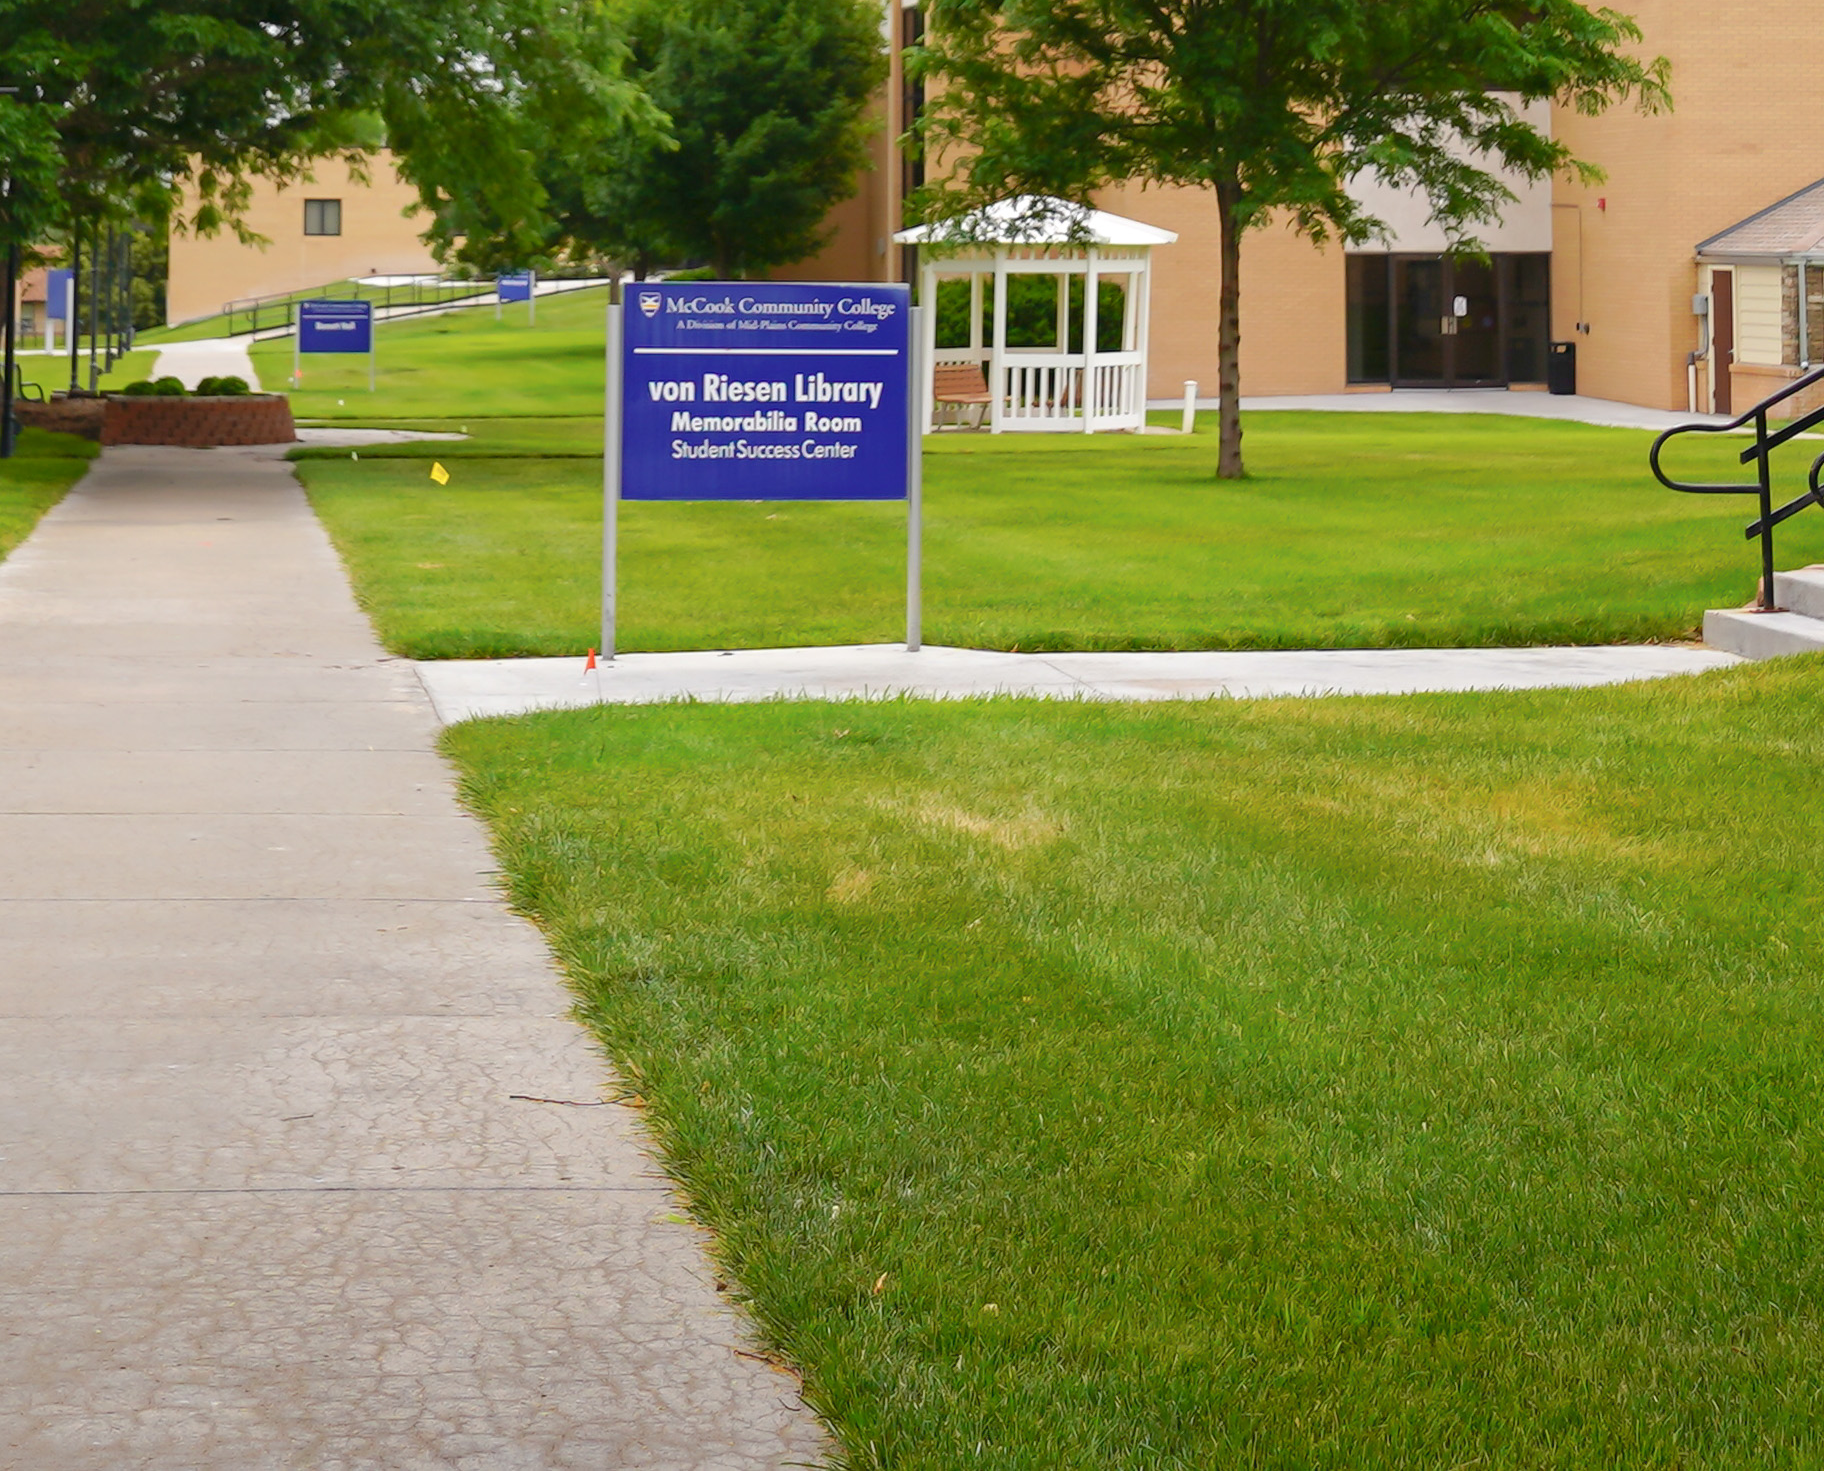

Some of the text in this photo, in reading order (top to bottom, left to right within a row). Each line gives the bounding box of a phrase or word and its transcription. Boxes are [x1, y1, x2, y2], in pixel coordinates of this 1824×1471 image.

[666, 297, 896, 320] McCook Community College
[676, 320, 686, 329] A
[686, 319, 725, 329] Division
[726, 319, 738, 329] of
[788, 320, 842, 332] Community
[844, 320, 878, 333] College
[648, 372, 884, 410] von Riesen Library
[671, 410, 862, 432] Memorabilia Room
[671, 438, 858, 459] Student Success Center
